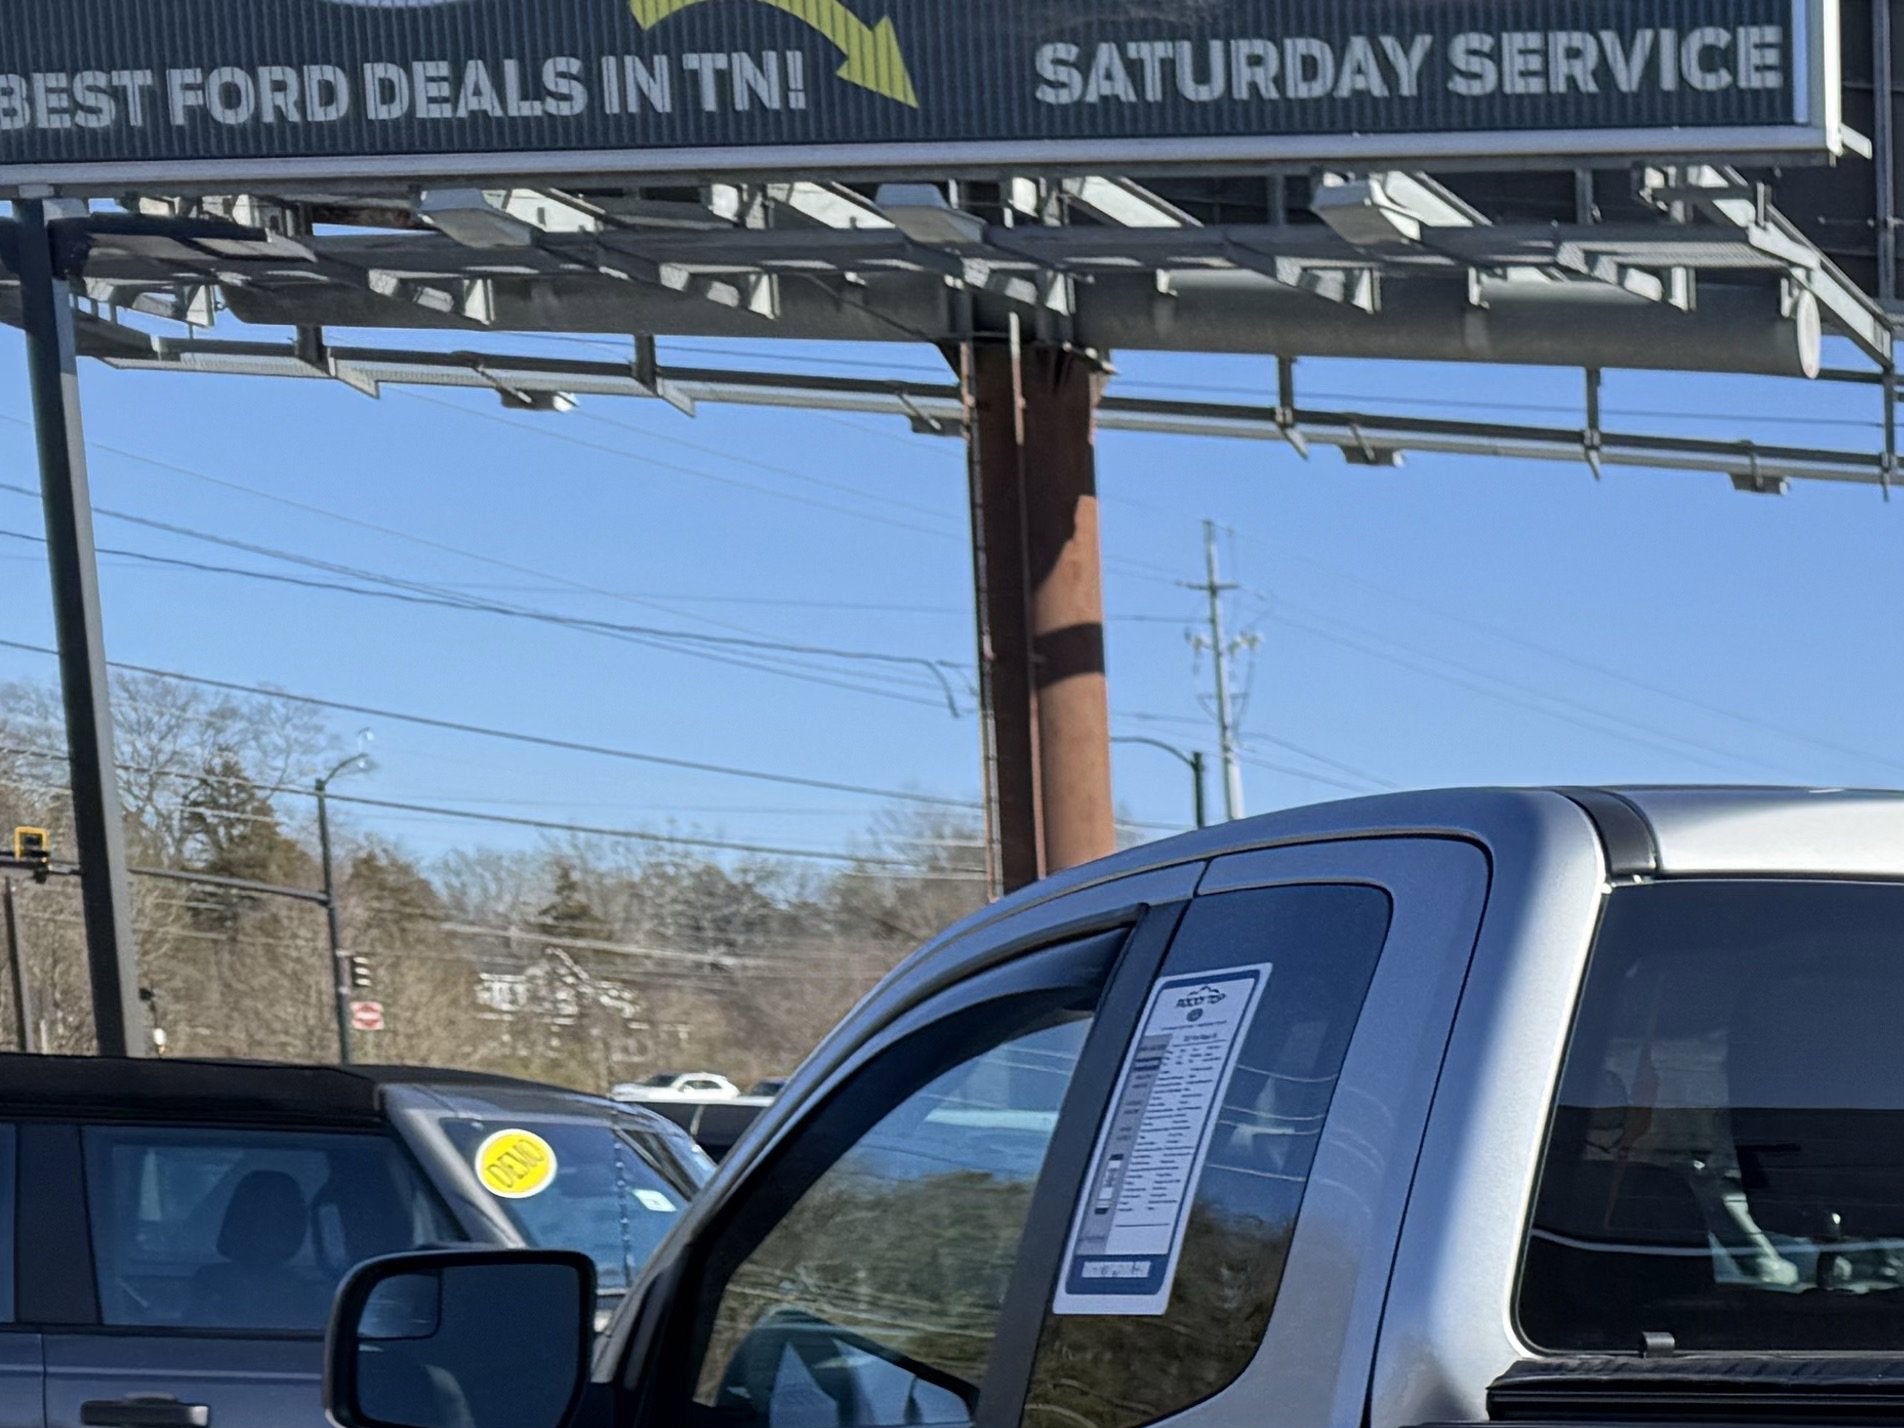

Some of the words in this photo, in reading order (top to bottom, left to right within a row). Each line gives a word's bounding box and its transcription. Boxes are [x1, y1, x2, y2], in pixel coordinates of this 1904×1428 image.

[0, 69, 152, 130] BEST
[166, 64, 349, 126] FORD
[363, 56, 588, 121] DEALS
[602, 53, 672, 116] IN
[682, 51, 805, 112] TN!
[1035, 33, 1433, 105] SATURDAY
[1447, 26, 1784, 96] SERVICE
